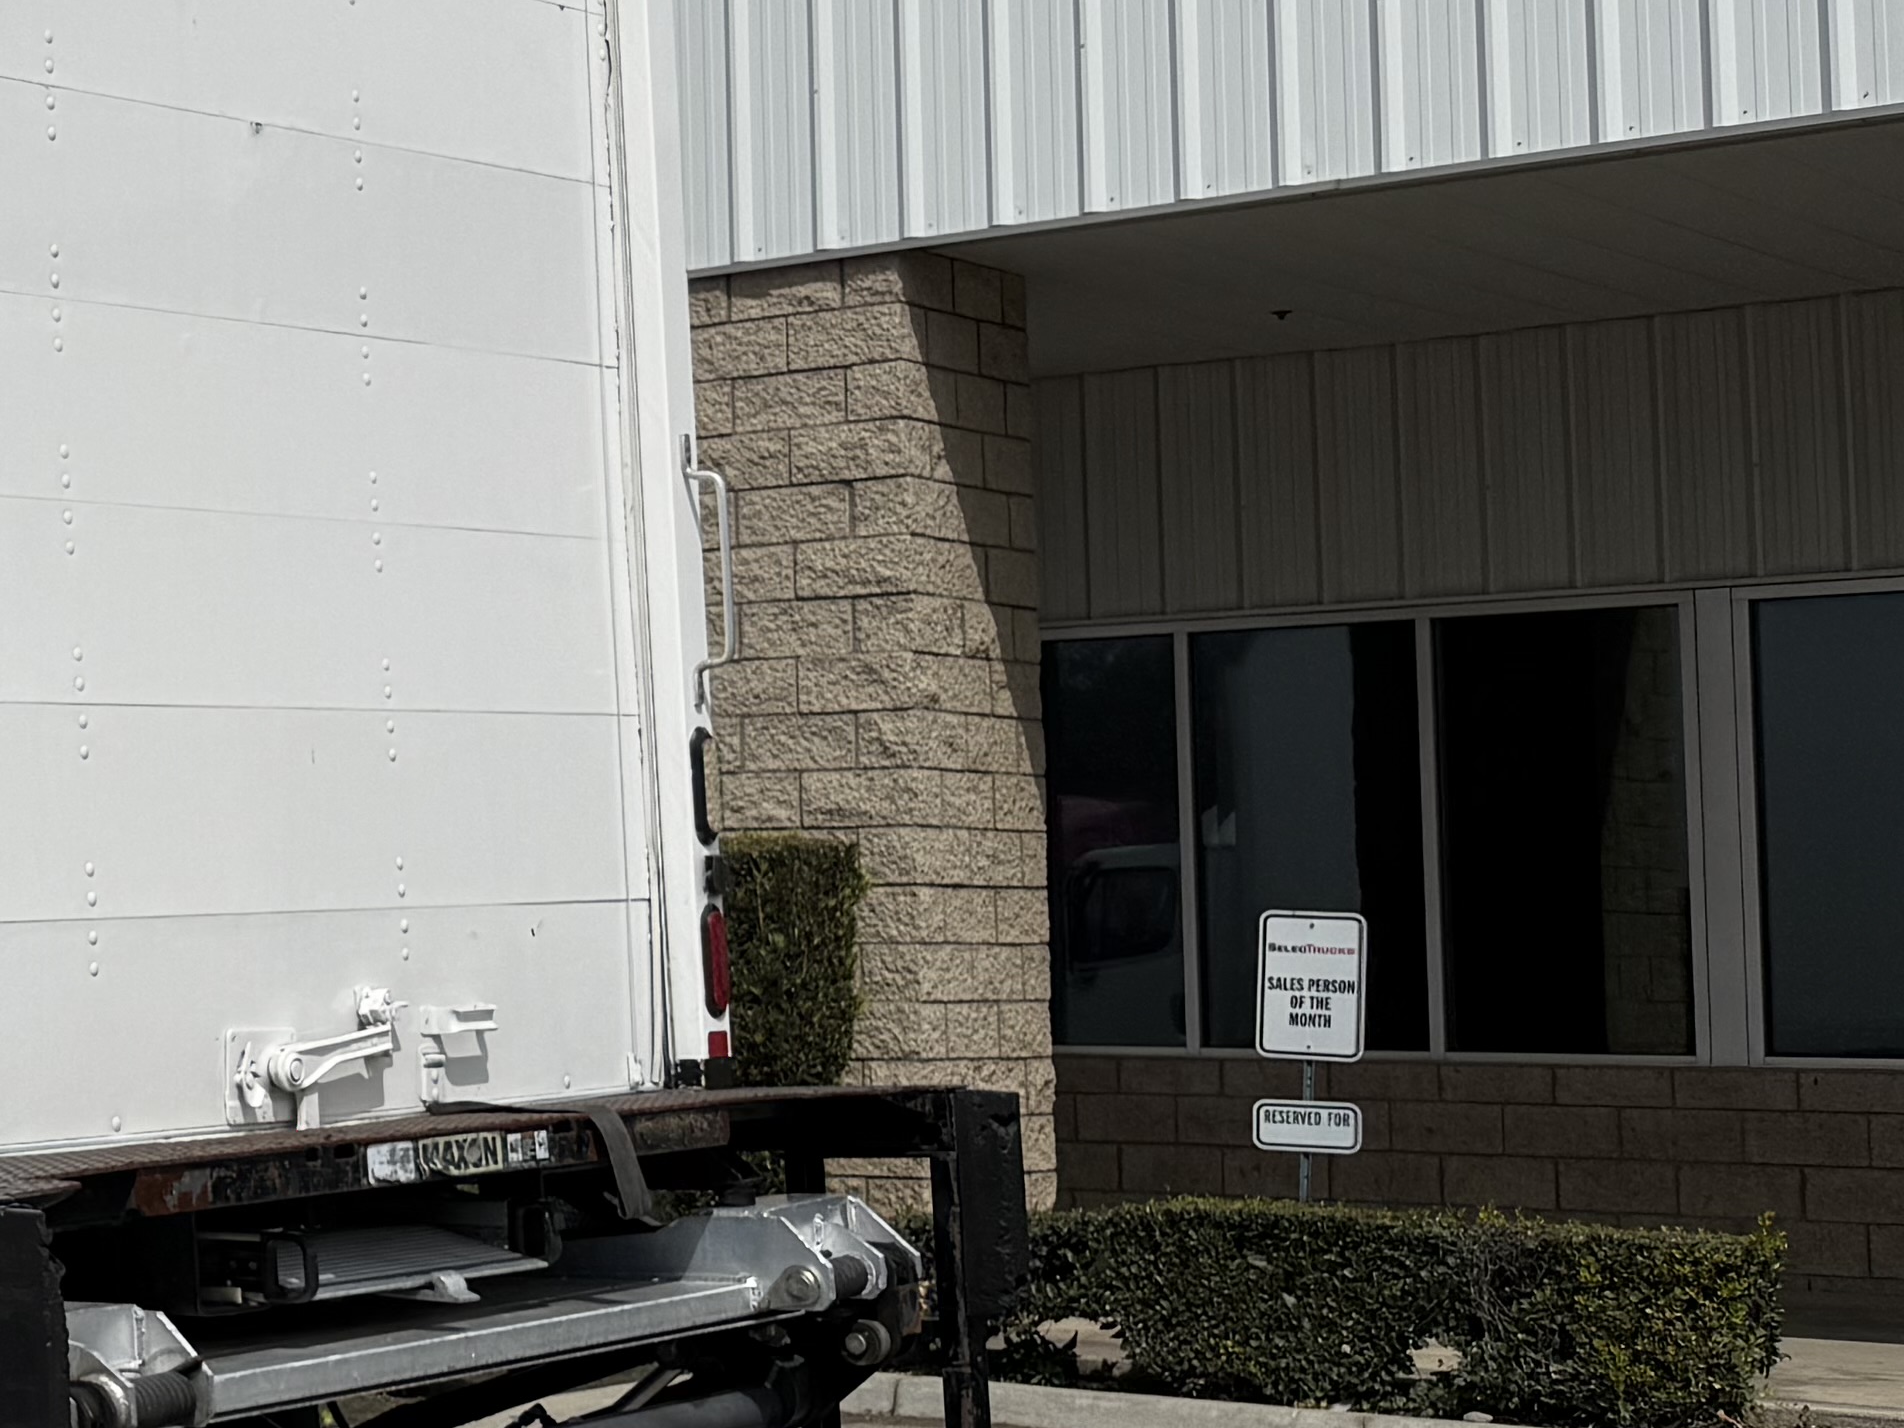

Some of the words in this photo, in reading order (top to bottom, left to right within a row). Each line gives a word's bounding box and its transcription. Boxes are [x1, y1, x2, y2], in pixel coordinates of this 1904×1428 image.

[1267, 976, 1304, 992] SALES
[1307, 977, 1356, 996] PERSON
[1289, 996, 1306, 1010] OF
[1308, 997, 1332, 1012] THE
[1288, 1012, 1332, 1029] MONTH
[1264, 1109, 1322, 1126] RESERVED
[1327, 1111, 1351, 1128] FOR
